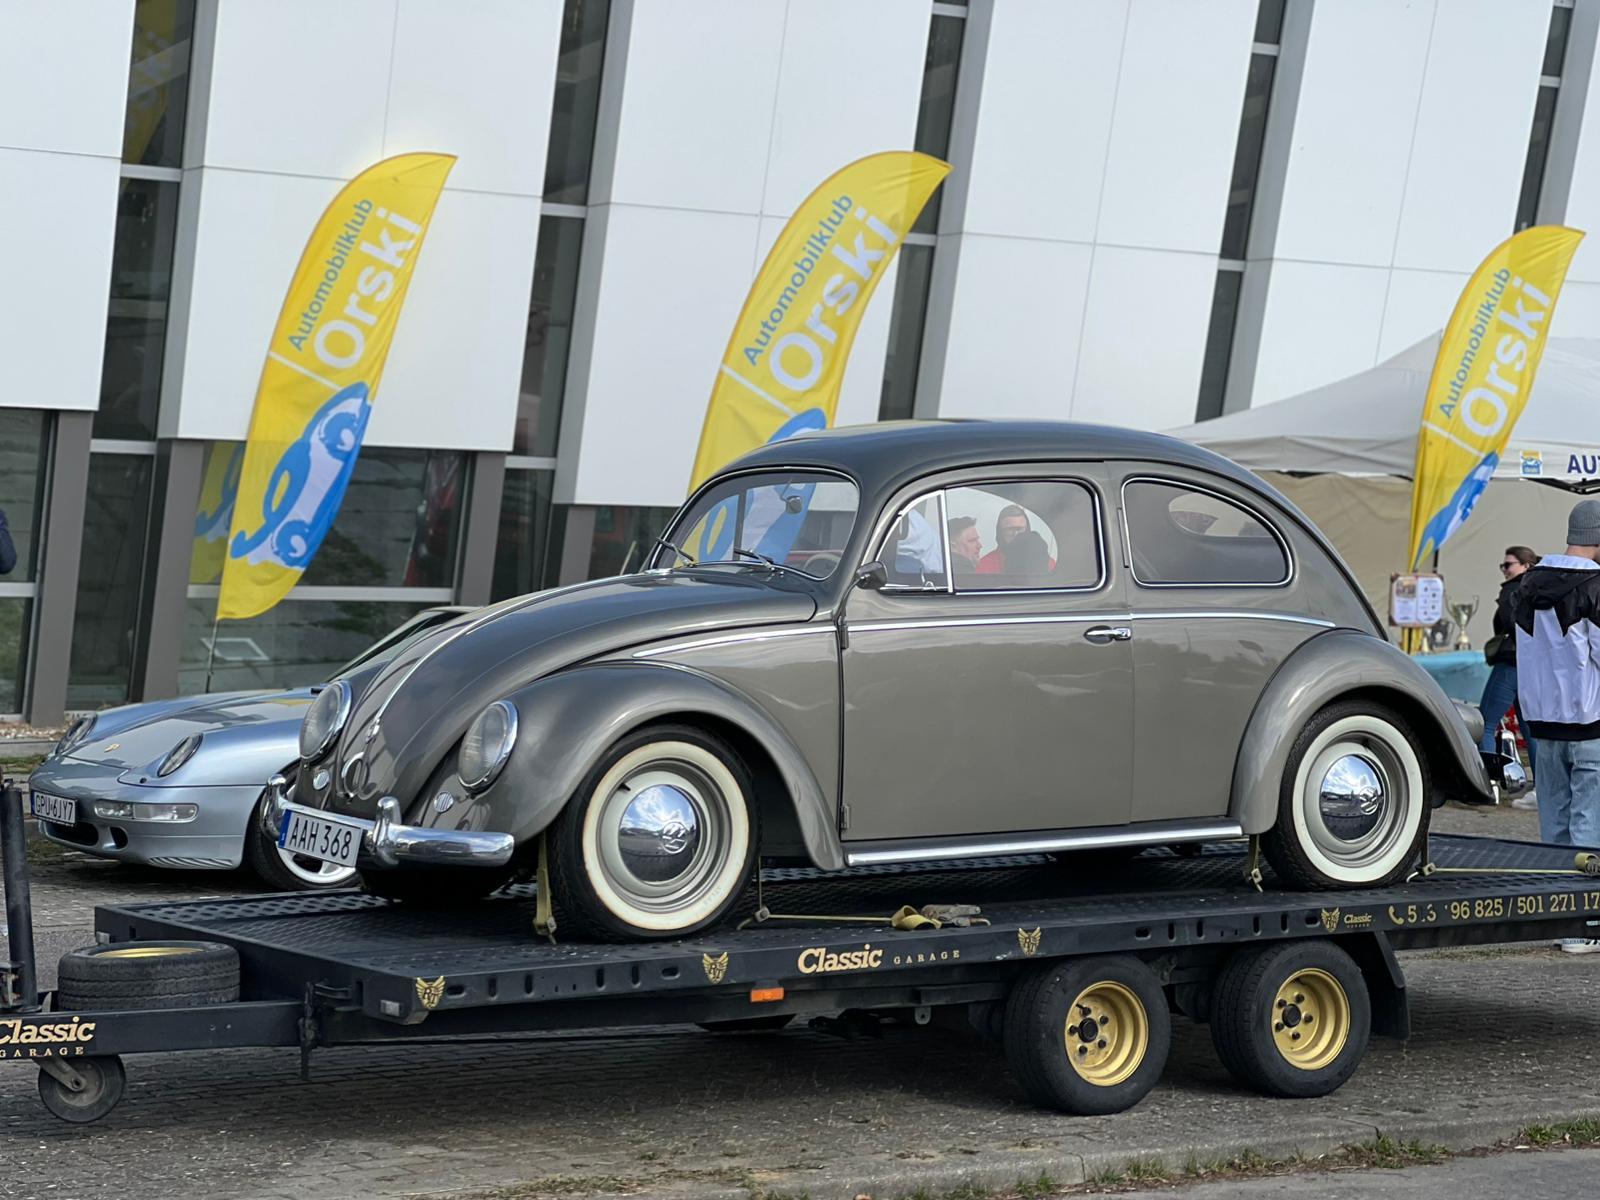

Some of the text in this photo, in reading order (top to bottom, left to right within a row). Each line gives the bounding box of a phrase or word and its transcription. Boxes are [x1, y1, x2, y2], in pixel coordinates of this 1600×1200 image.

[287, 198, 374, 352] Automobilklub
[313, 206, 422, 369] Orski
[742, 193, 853, 367] Automobilklub
[769, 206, 898, 392] Orski
[1439, 267, 1511, 419] Automobilklub
[1460, 275, 1552, 437] Orski
[1567, 454, 1600, 474] AU
[289, 817, 352, 860] AAH 368
[1474, 898, 1503, 918] 825
[1517, 895, 1544, 915] 501
[1550, 893, 1577, 913] 271
[797, 943, 960, 974] Classic GARAGE
[0, 1046, 84, 1058] GARAGE
